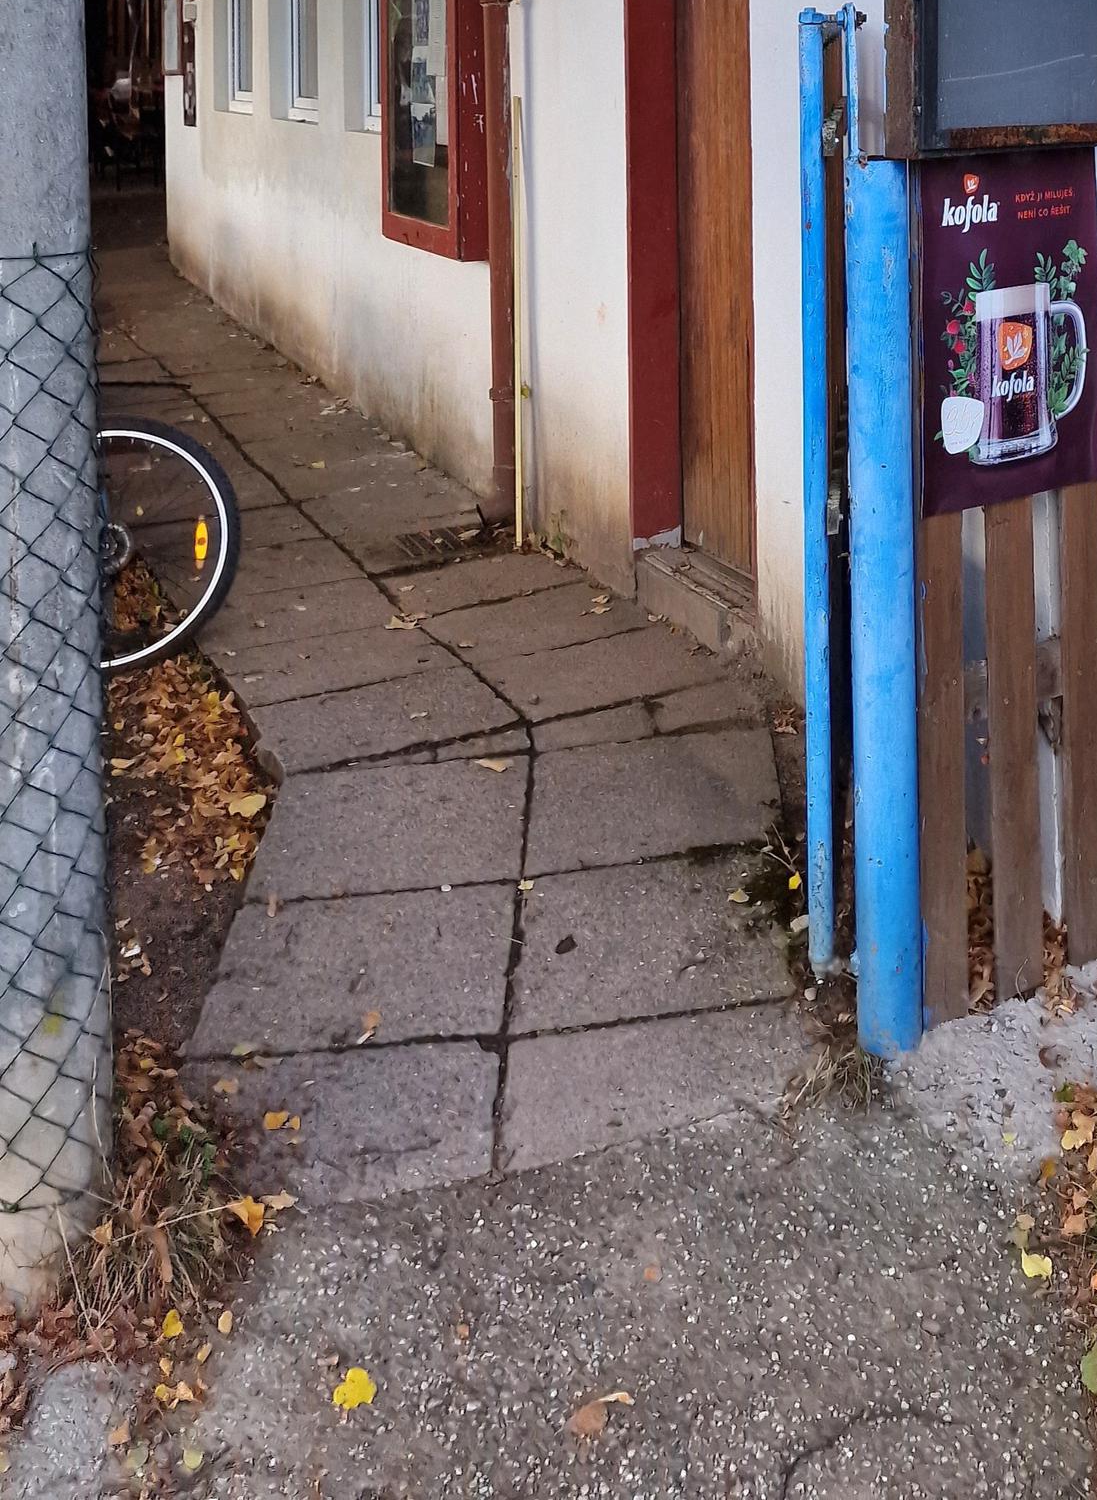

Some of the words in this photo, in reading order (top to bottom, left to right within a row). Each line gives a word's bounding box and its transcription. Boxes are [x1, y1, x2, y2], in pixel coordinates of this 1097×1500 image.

[1015, 190, 1035, 203] KDYŽ
[941, 194, 998, 233] kofola
[1037, 208, 1049, 217] CO
[991, 369, 1035, 403] kofola
